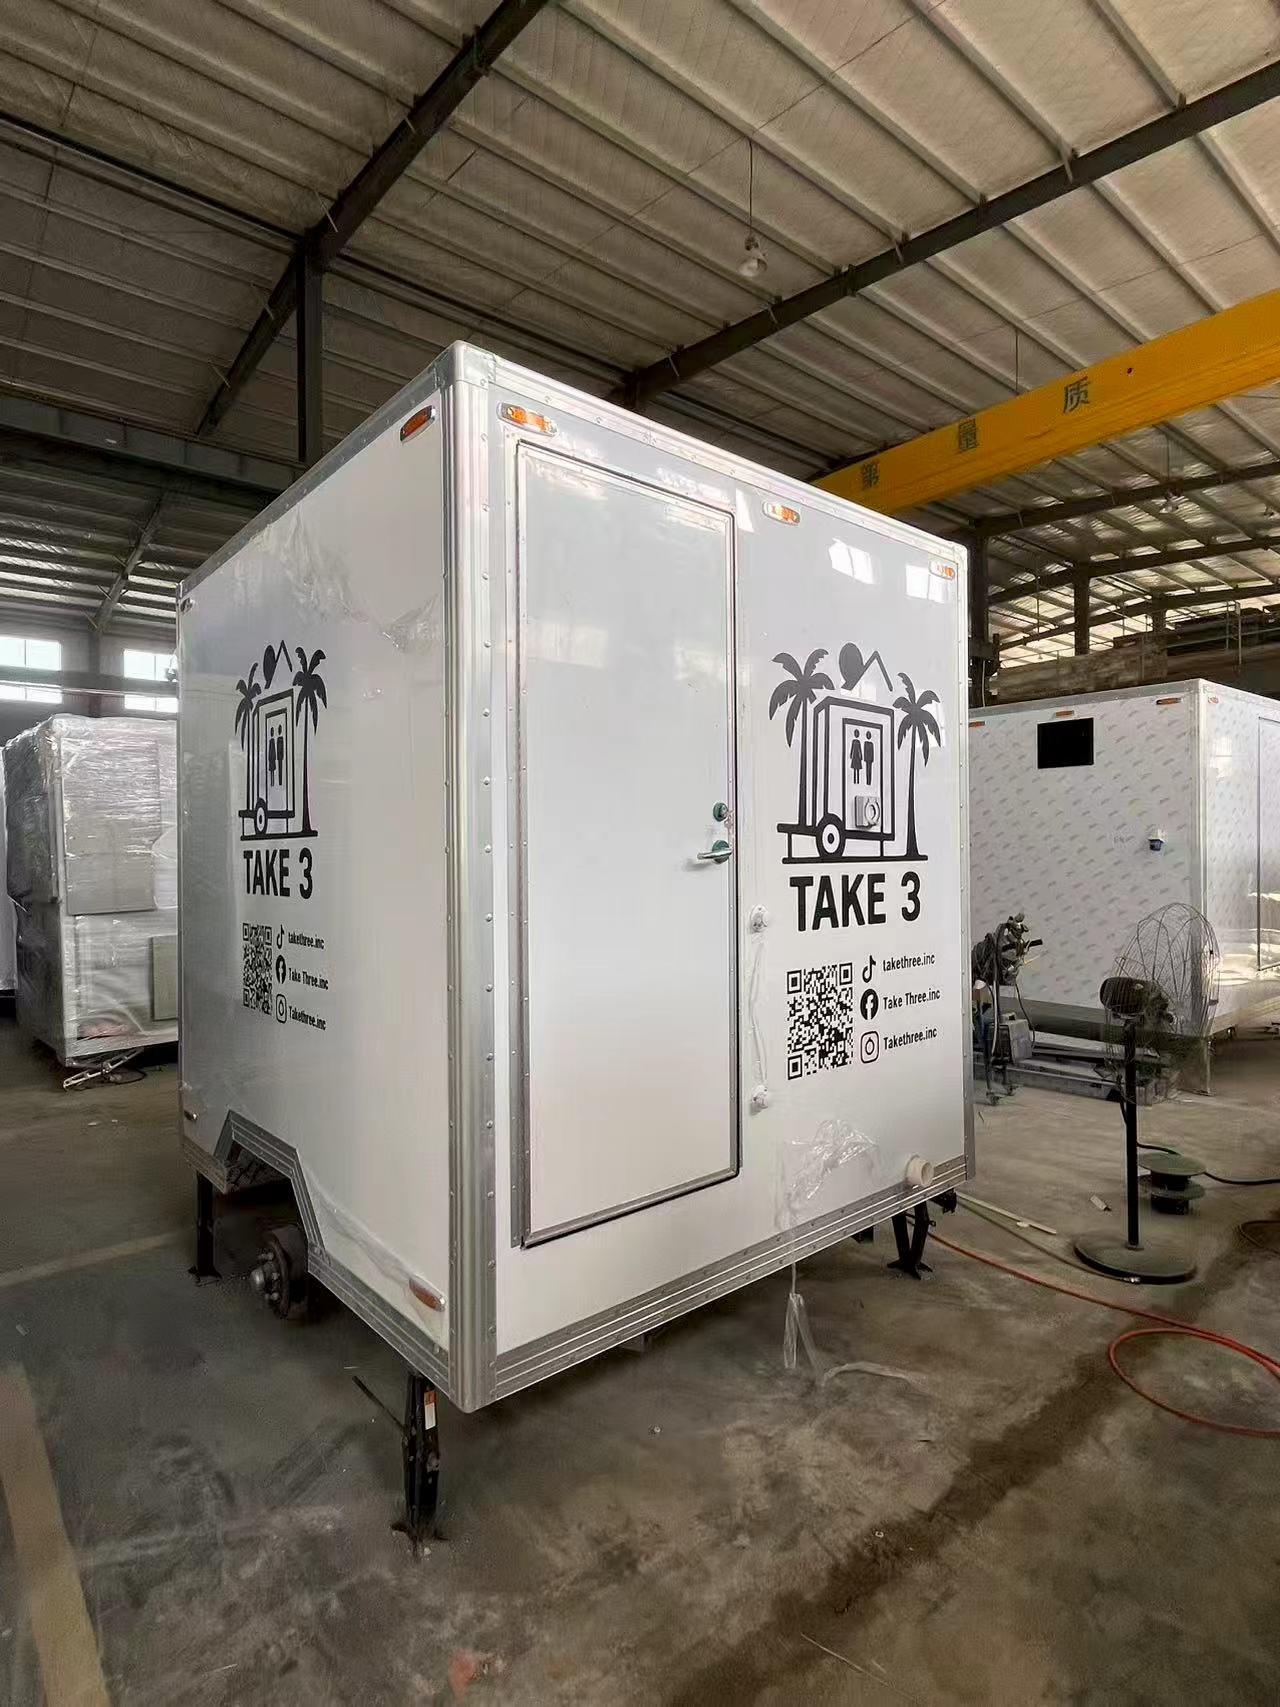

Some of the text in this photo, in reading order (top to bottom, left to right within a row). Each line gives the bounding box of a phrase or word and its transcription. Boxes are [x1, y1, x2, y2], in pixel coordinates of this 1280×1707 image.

[243, 847, 314, 899] TAKE 3
[789, 871, 921, 932] TAKE 3
[288, 931, 325, 950] takethree.inc
[882, 952, 936, 972] takethree.inc
[289, 967, 329, 991] Take Three.inc
[883, 987, 941, 1010] Take Three.inc
[289, 1005, 326, 1031] Takethree.inc
[883, 1026, 938, 1051] Takethree.inc
